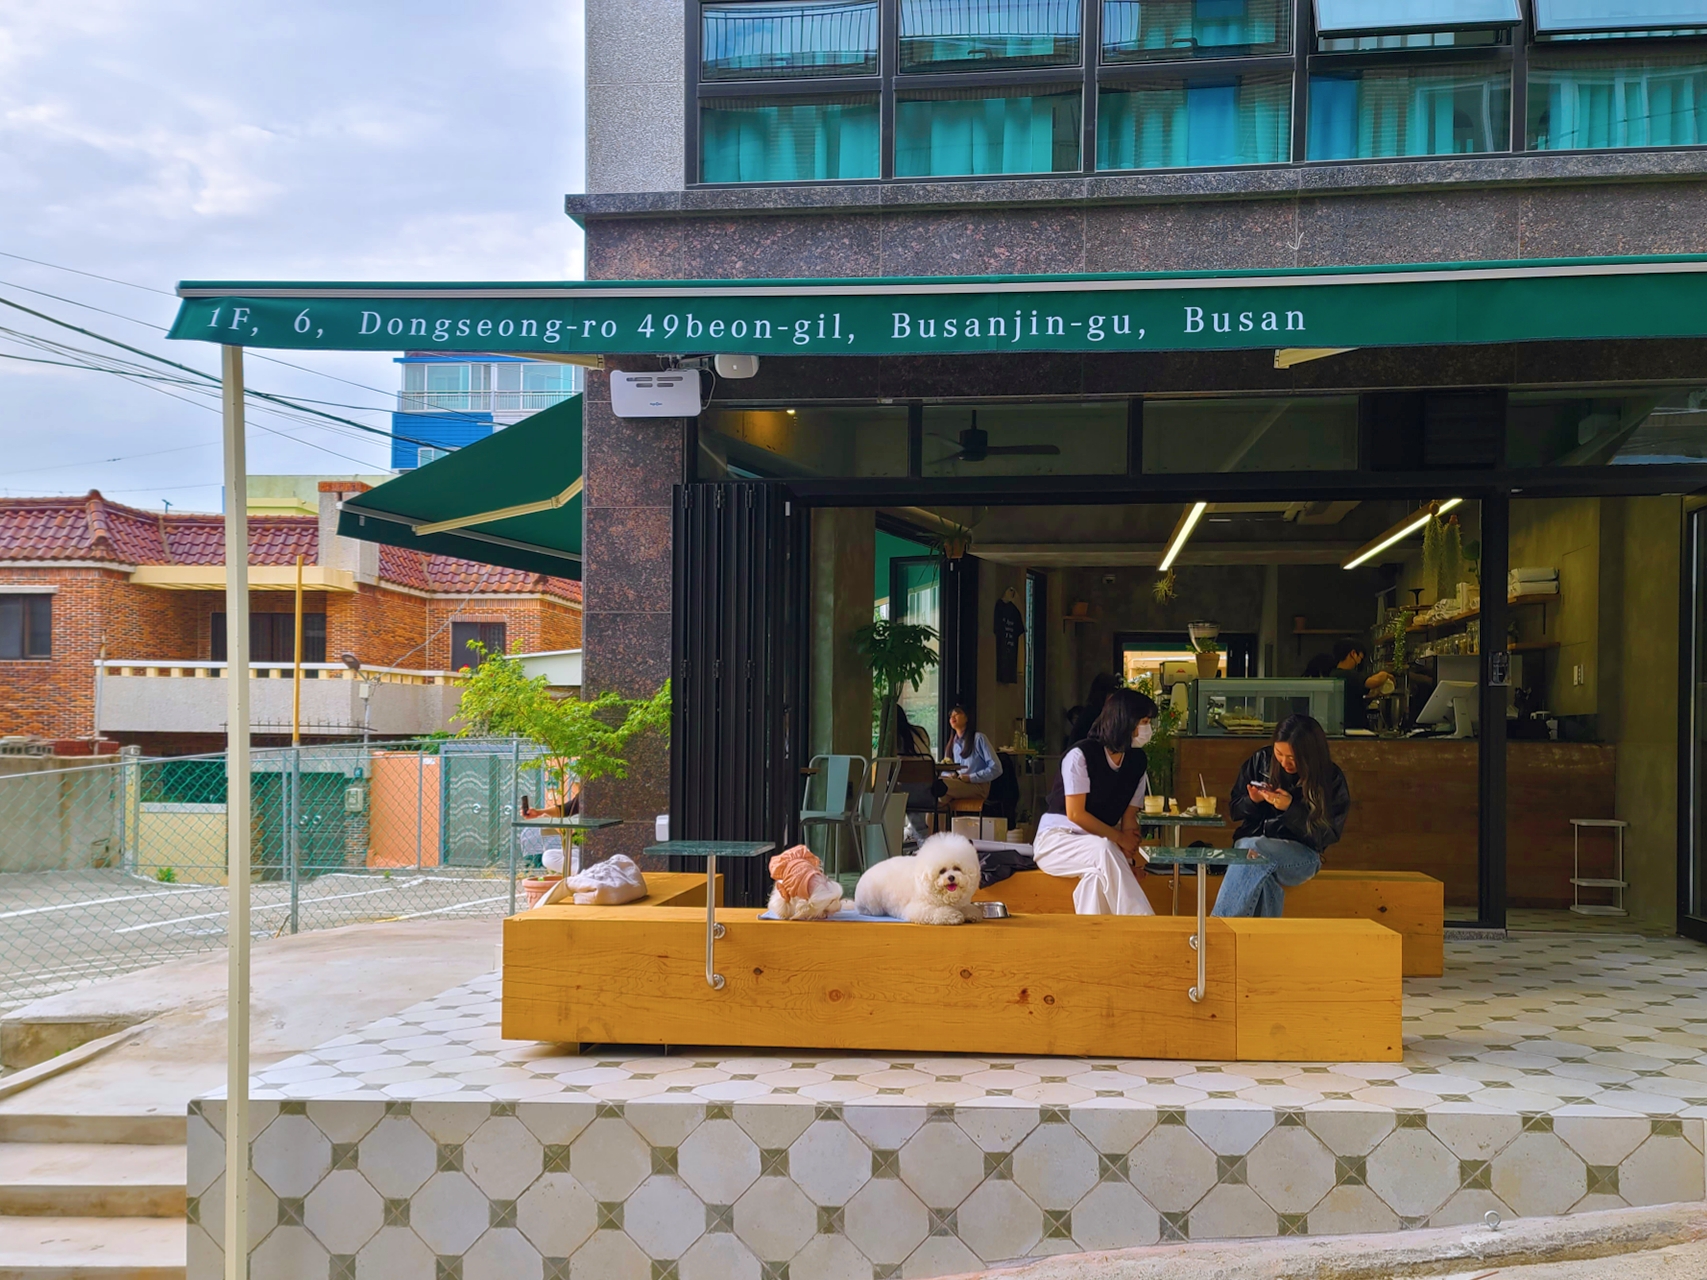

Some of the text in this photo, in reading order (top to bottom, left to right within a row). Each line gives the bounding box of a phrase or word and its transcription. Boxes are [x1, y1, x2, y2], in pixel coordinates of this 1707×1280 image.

[207, 305, 1307, 346] 1F, 6, Dongseong-ro 49beon-gil, Busanjin-gu, Busan
